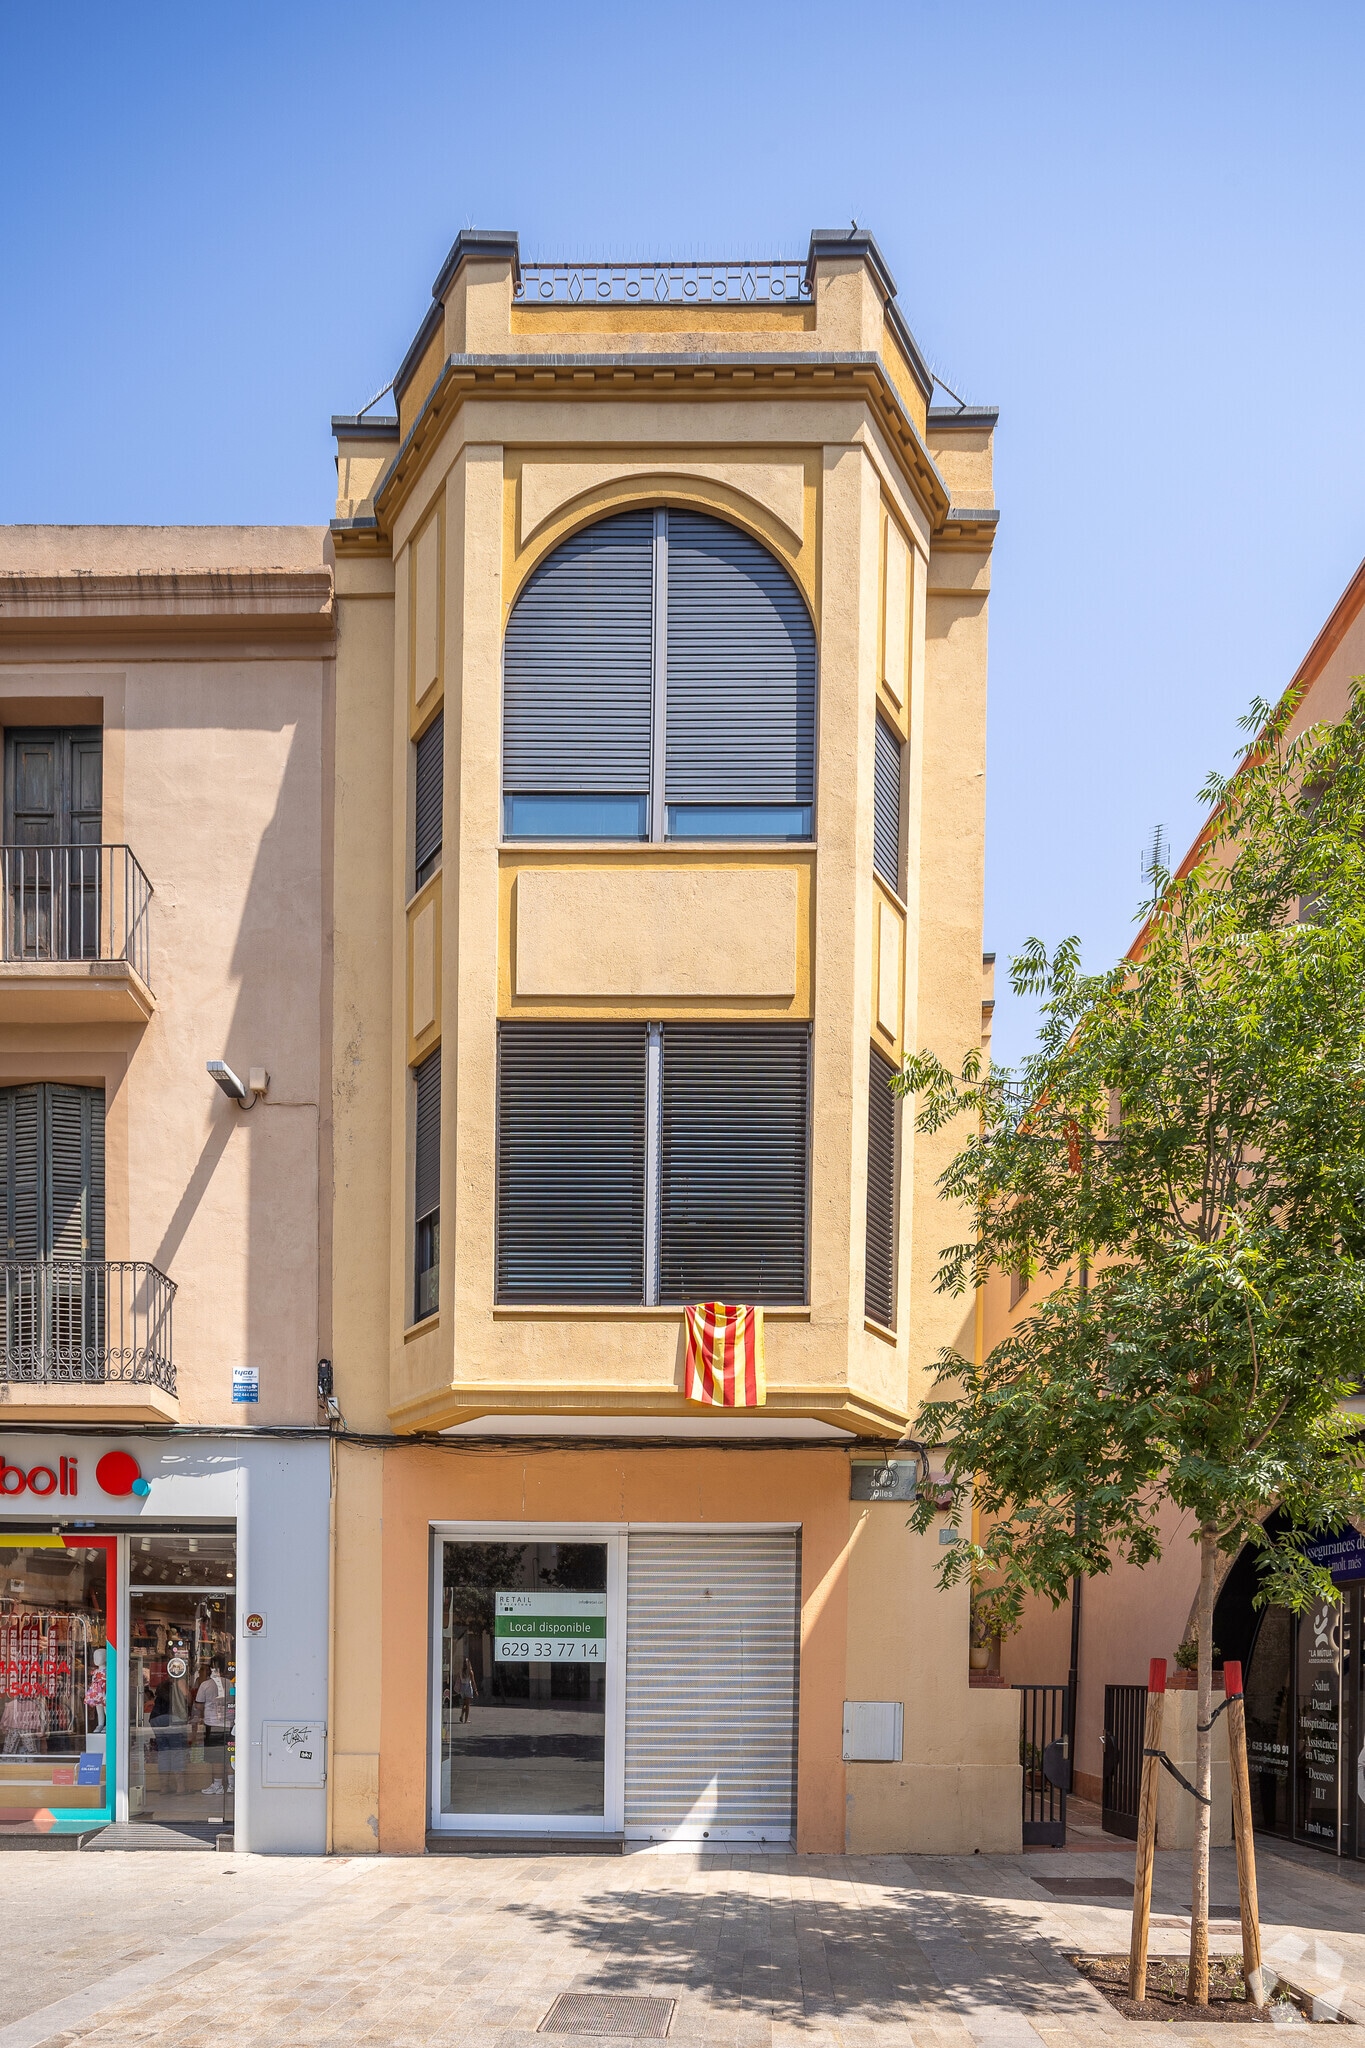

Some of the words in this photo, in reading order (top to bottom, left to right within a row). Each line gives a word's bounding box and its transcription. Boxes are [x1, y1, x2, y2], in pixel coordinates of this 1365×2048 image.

[0, 1455, 78, 1496] boli
[510, 1622, 536, 1632] Local
[540, 1622, 591, 1634] disponible
[501, 1642, 529, 1656] 629
[534, 1642, 552, 1656] 33
[557, 1643, 575, 1657] 77
[581, 1643, 598, 1657] 14
[5, 1682, 49, 1697] -50%
[1314, 1680, 1330, 1691] Salut
[1312, 1699, 1332, 1711] Dental
[1301, 1717, 1339, 1731] Hospitalitzac
[1252, 1741, 1262, 1751] 625
[1272, 1744, 1281, 1754] 99
[1313, 1749, 1335, 1765] Viatges
[1308, 1767, 1334, 1782] Decessos
[1315, 1787, 1326, 1800] ILT
